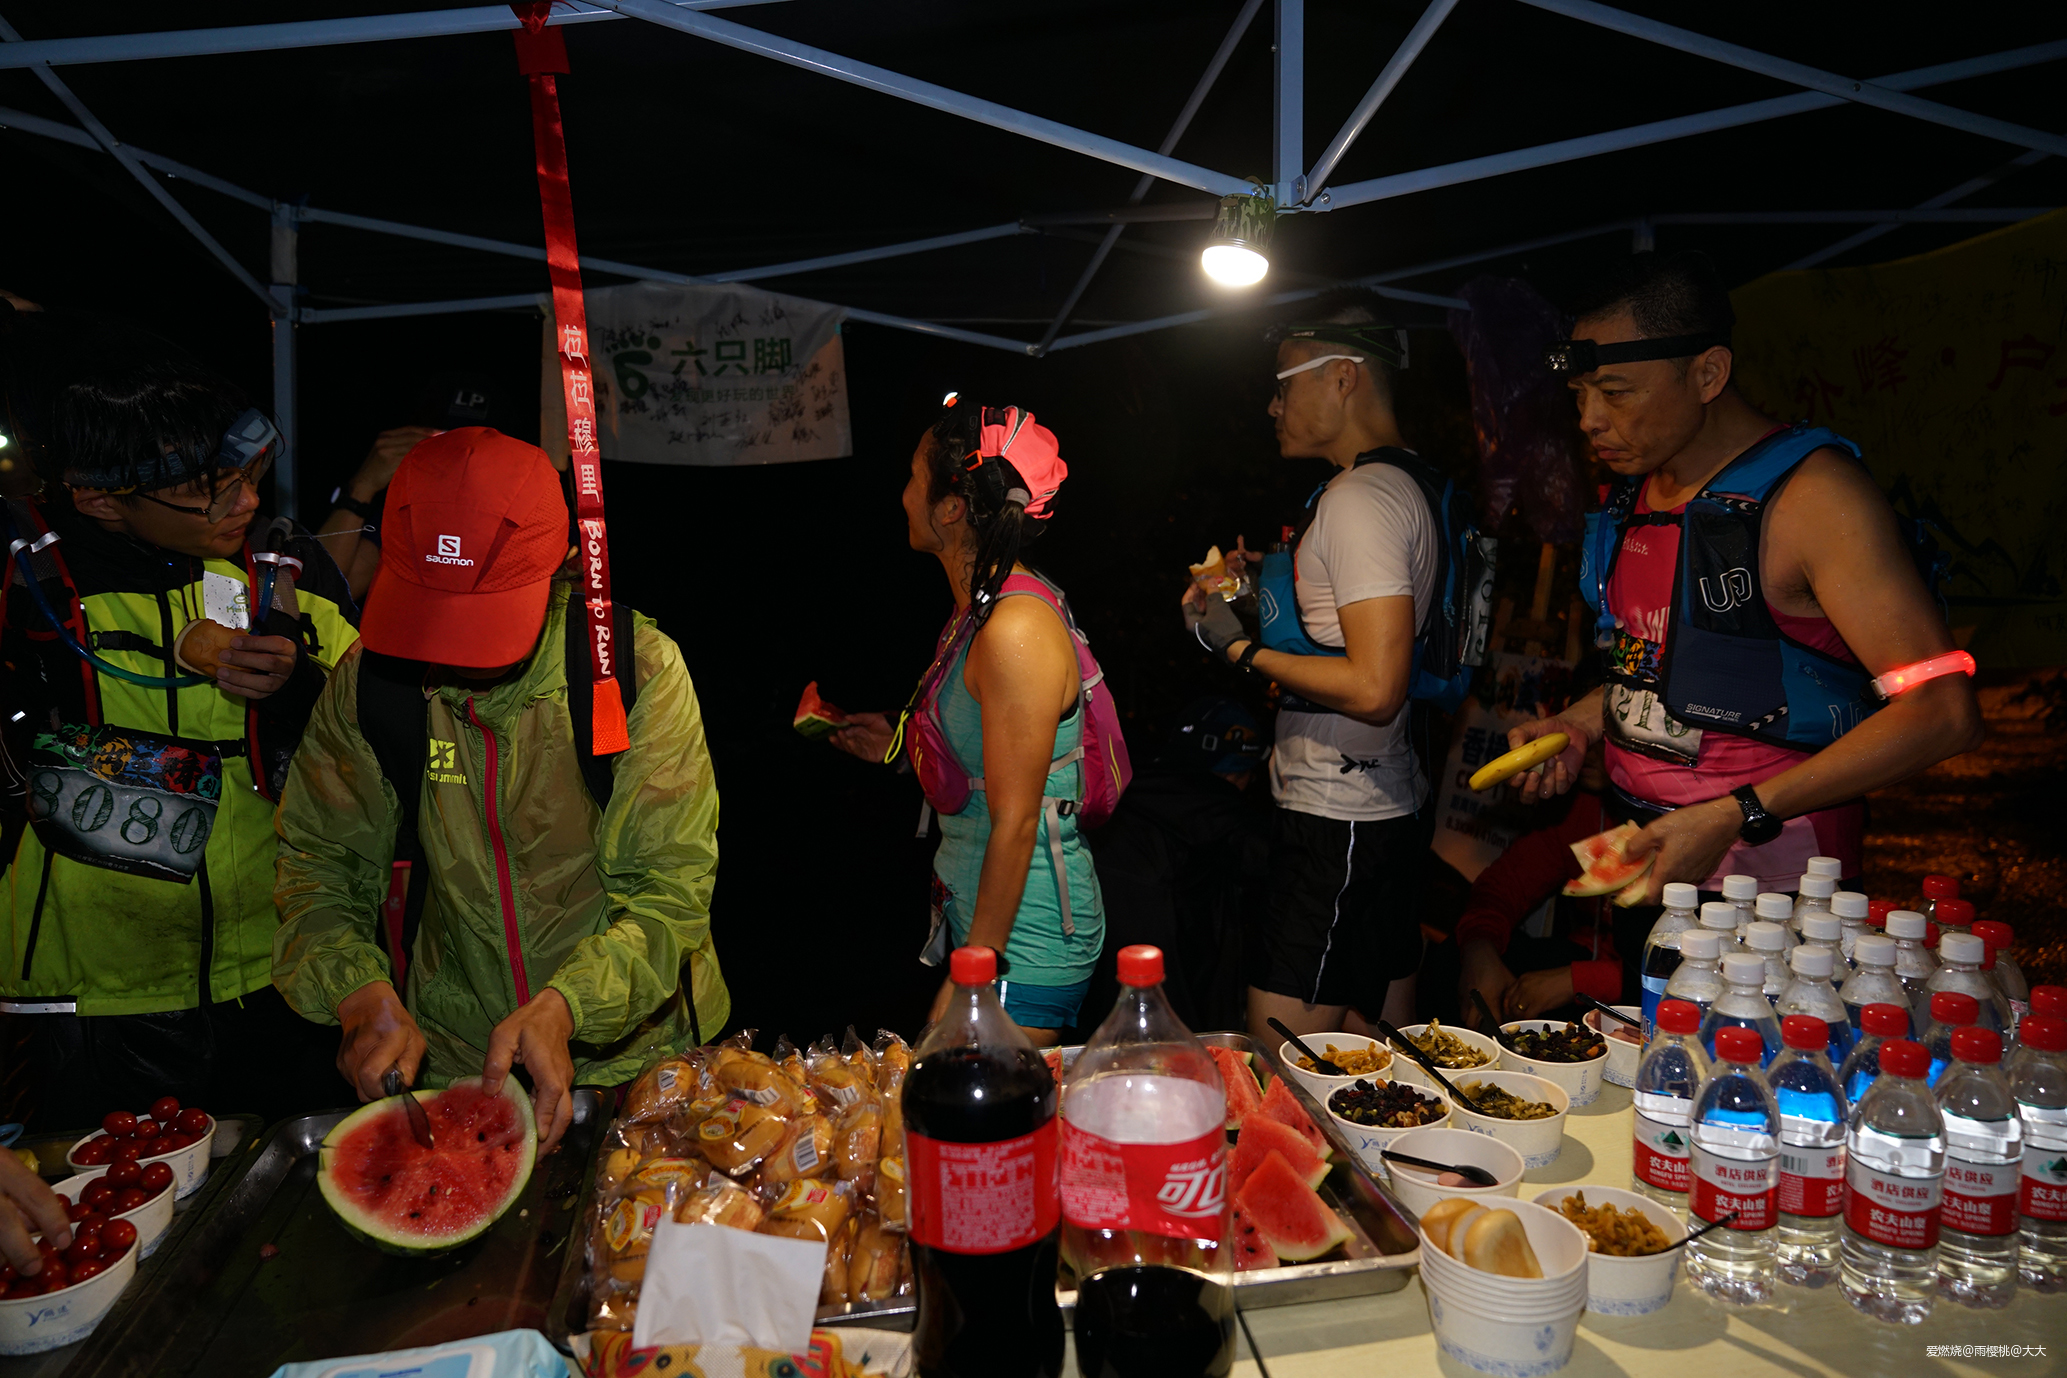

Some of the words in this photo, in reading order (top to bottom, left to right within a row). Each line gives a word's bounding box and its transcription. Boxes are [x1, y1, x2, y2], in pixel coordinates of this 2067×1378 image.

[671, 337, 792, 376] 六只脚
[455, 390, 486, 407] LP
[425, 554, 474, 567] salomon
[583, 519, 605, 590] BORN
[591, 593, 606, 620] TO
[594, 624, 612, 676] RUN
[1686, 702, 1742, 719] SIGNATURE
[32, 771, 208, 855] 8080
[1649, 1155, 1690, 1174] 农夫山
[1714, 1163, 1768, 1182] 酒店供应
[1945, 1165, 1994, 1186] 店供应
[1870, 1177, 1930, 1200] 酒店供应
[1714, 1194, 1767, 1212] 农夫山泉
[1869, 1208, 1928, 1230] 农夫山泉
